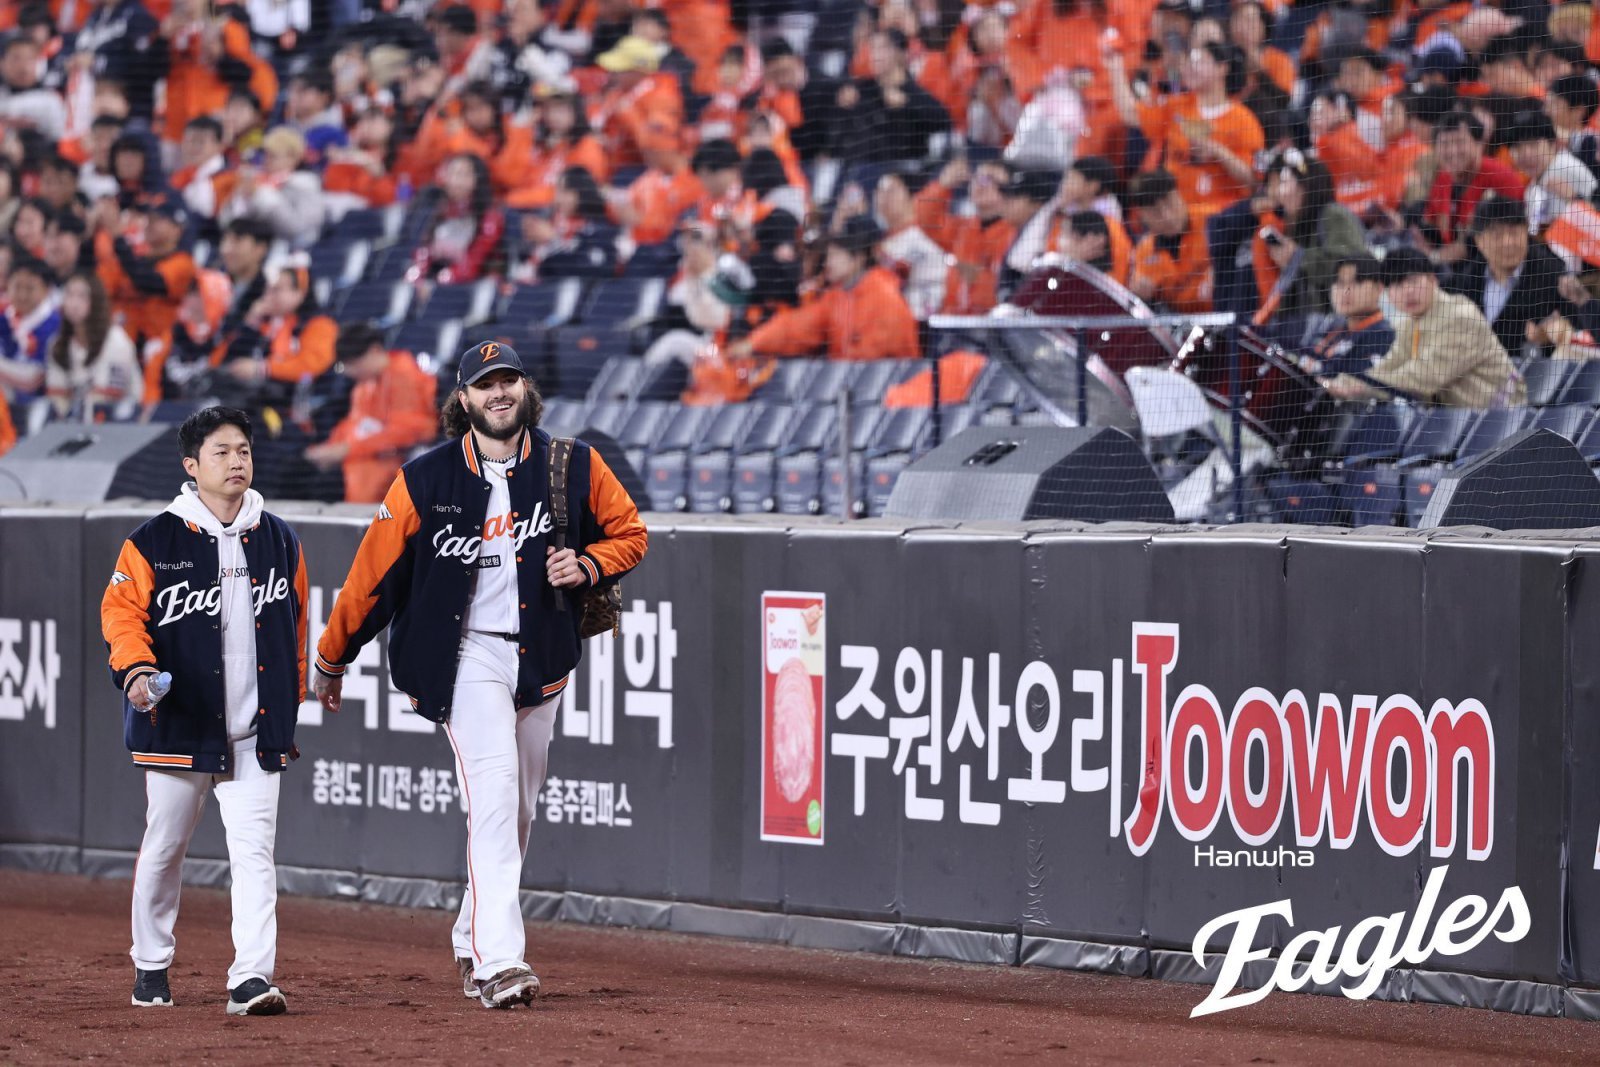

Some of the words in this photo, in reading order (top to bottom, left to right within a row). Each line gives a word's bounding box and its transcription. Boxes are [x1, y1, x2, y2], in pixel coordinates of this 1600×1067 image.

[480, 343, 500, 363] E
[154, 561, 194, 570] Hanwha
[831, 645, 1123, 837] 주원산오리
[1124, 621, 1494, 861] Joowon
[313, 758, 361, 805] 충청도
